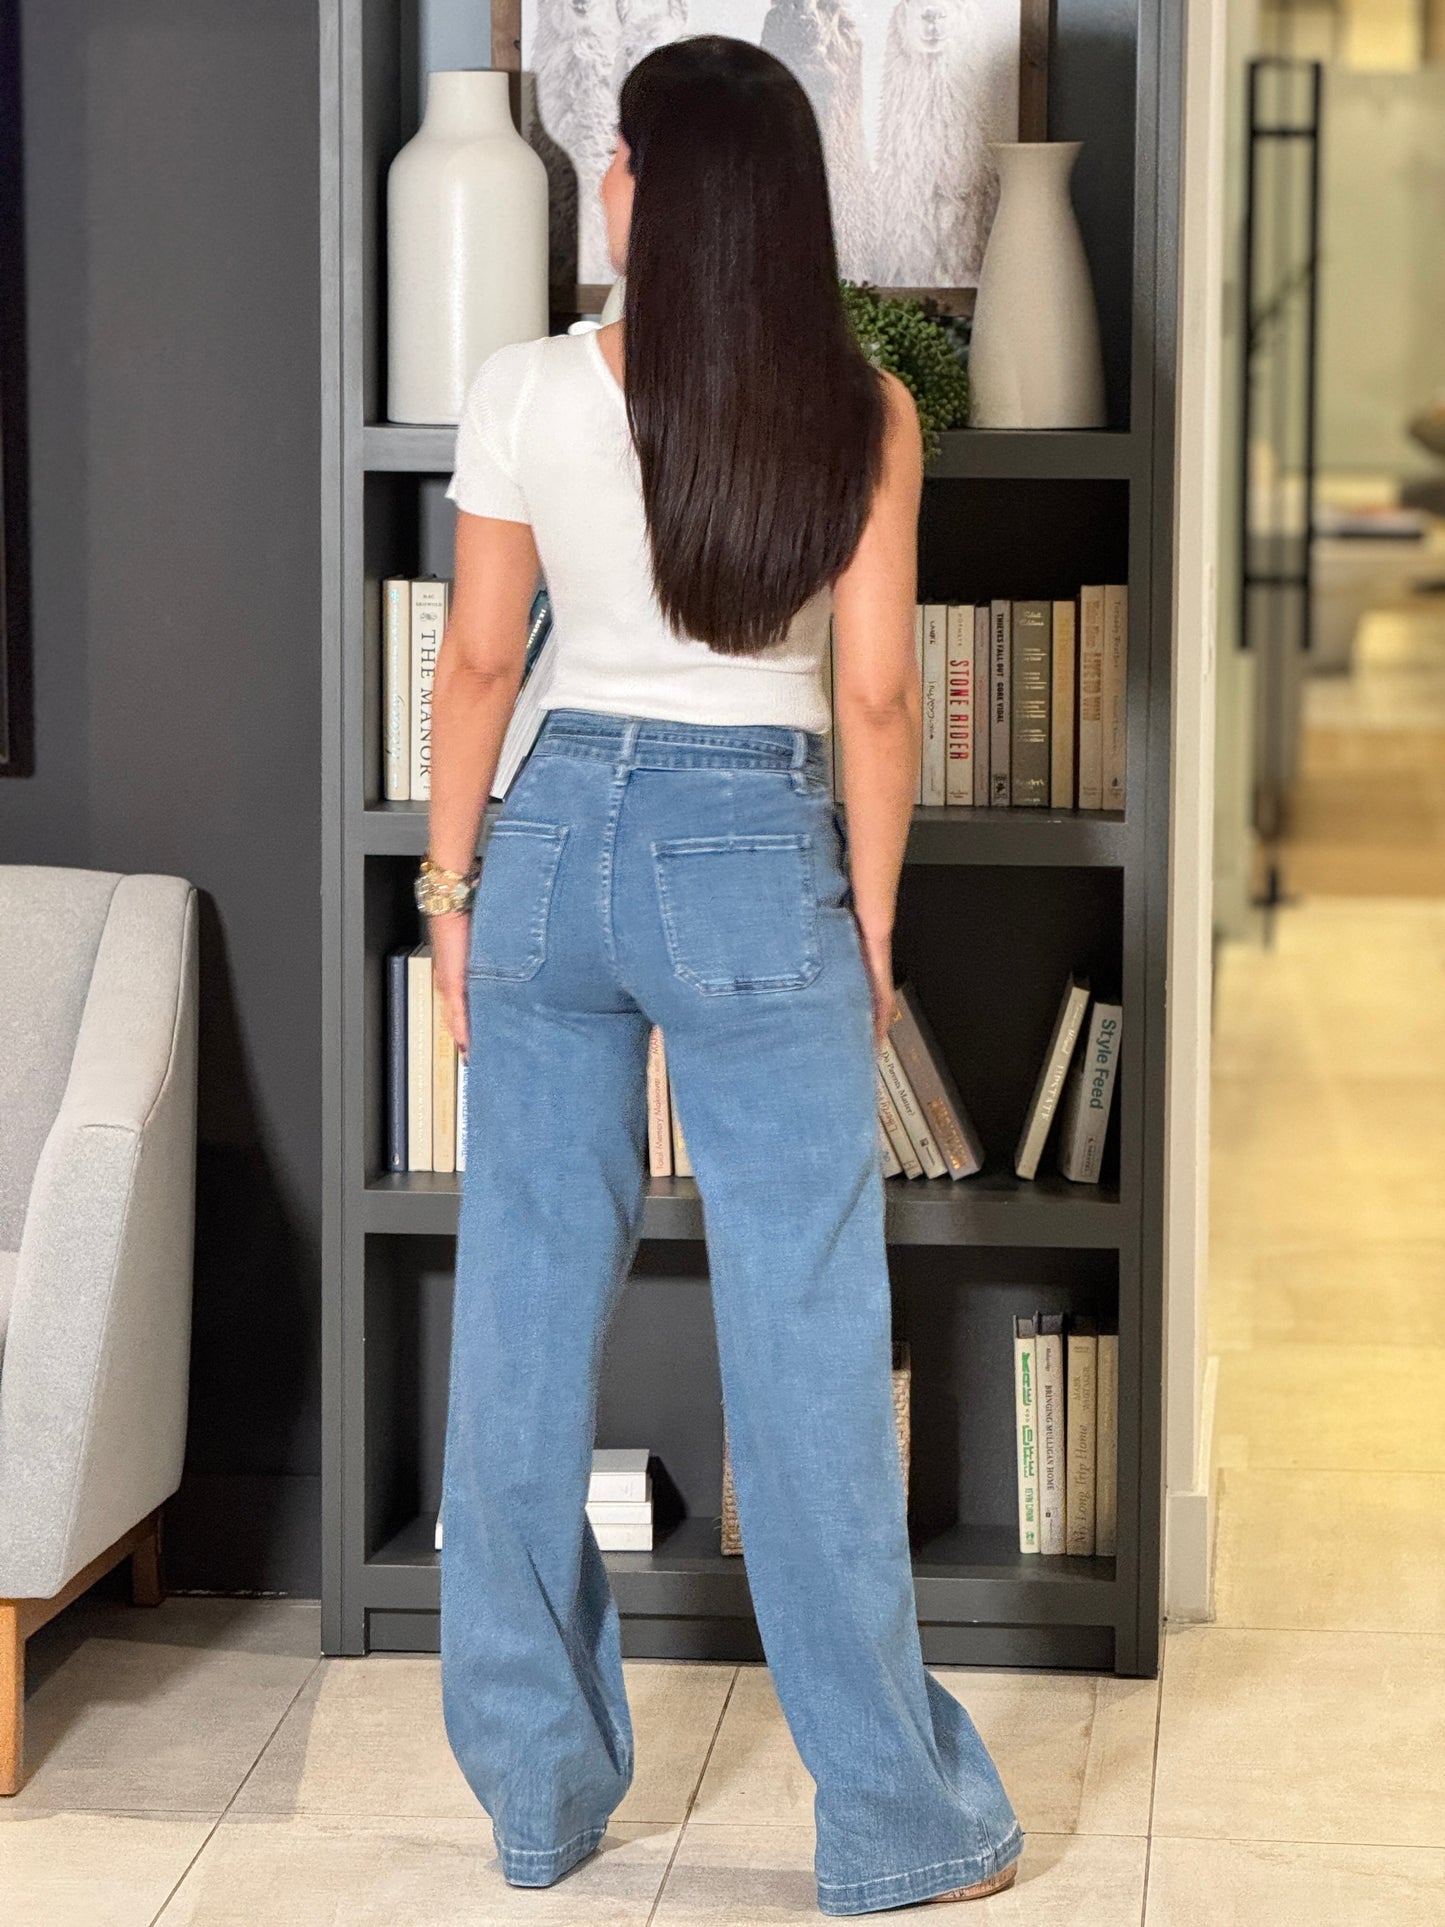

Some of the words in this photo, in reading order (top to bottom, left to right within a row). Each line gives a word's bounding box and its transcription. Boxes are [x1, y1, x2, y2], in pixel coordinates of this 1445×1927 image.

[526, 619, 542, 649] ROWLING
[996, 613, 1004, 642] THIEVES
[421, 629, 436, 679] THE
[996, 645, 1004, 661] FALL
[949, 659, 969, 706] STONE
[996, 663, 1004, 677] OUT
[996, 682, 1004, 701] GORE
[996, 703, 1004, 723] VIDAL
[420, 688, 434, 777] MANOR
[949, 714, 969, 760] RIDER
[1096, 1019, 1117, 1064] Style
[887, 1063, 901, 1089] Parents
[898, 1089, 915, 1117] Matter?
[1040, 1064, 1065, 1121] UPSTATE
[1090, 1068, 1110, 1110] Feed
[654, 1118, 664, 1149] Memory
[1045, 1385, 1053, 1423] BRINGING
[1046, 1424, 1054, 1465] MULLIGAN
[1074, 1424, 1088, 1459] Home
[1046, 1467, 1055, 1491] HOME
[1074, 1463, 1090, 1486] Trip
[1074, 1491, 1089, 1521] Long
[1074, 1526, 1088, 1543] My
